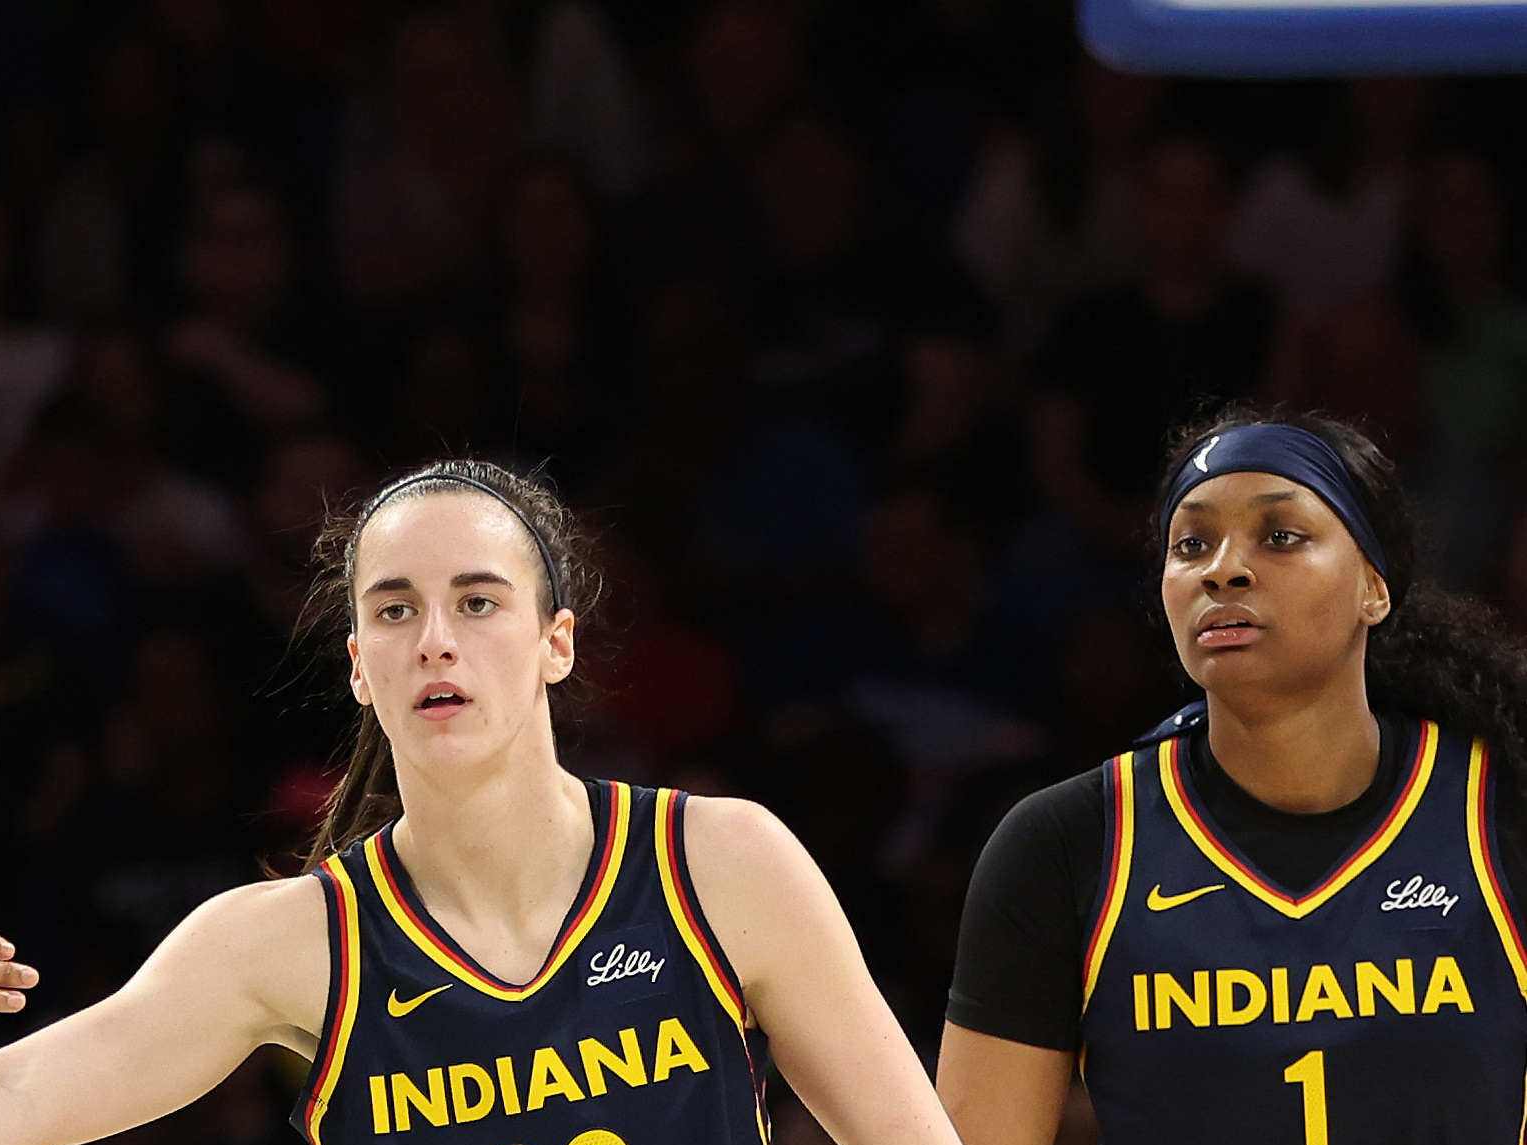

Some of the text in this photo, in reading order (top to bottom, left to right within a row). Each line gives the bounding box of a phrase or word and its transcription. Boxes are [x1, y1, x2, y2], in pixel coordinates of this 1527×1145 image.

[1382, 875, 1459, 915] Lilly
[586, 943, 666, 987] Lilly
[1133, 956, 1475, 1031] INDIANA
[368, 1017, 710, 1134] INDIANA
